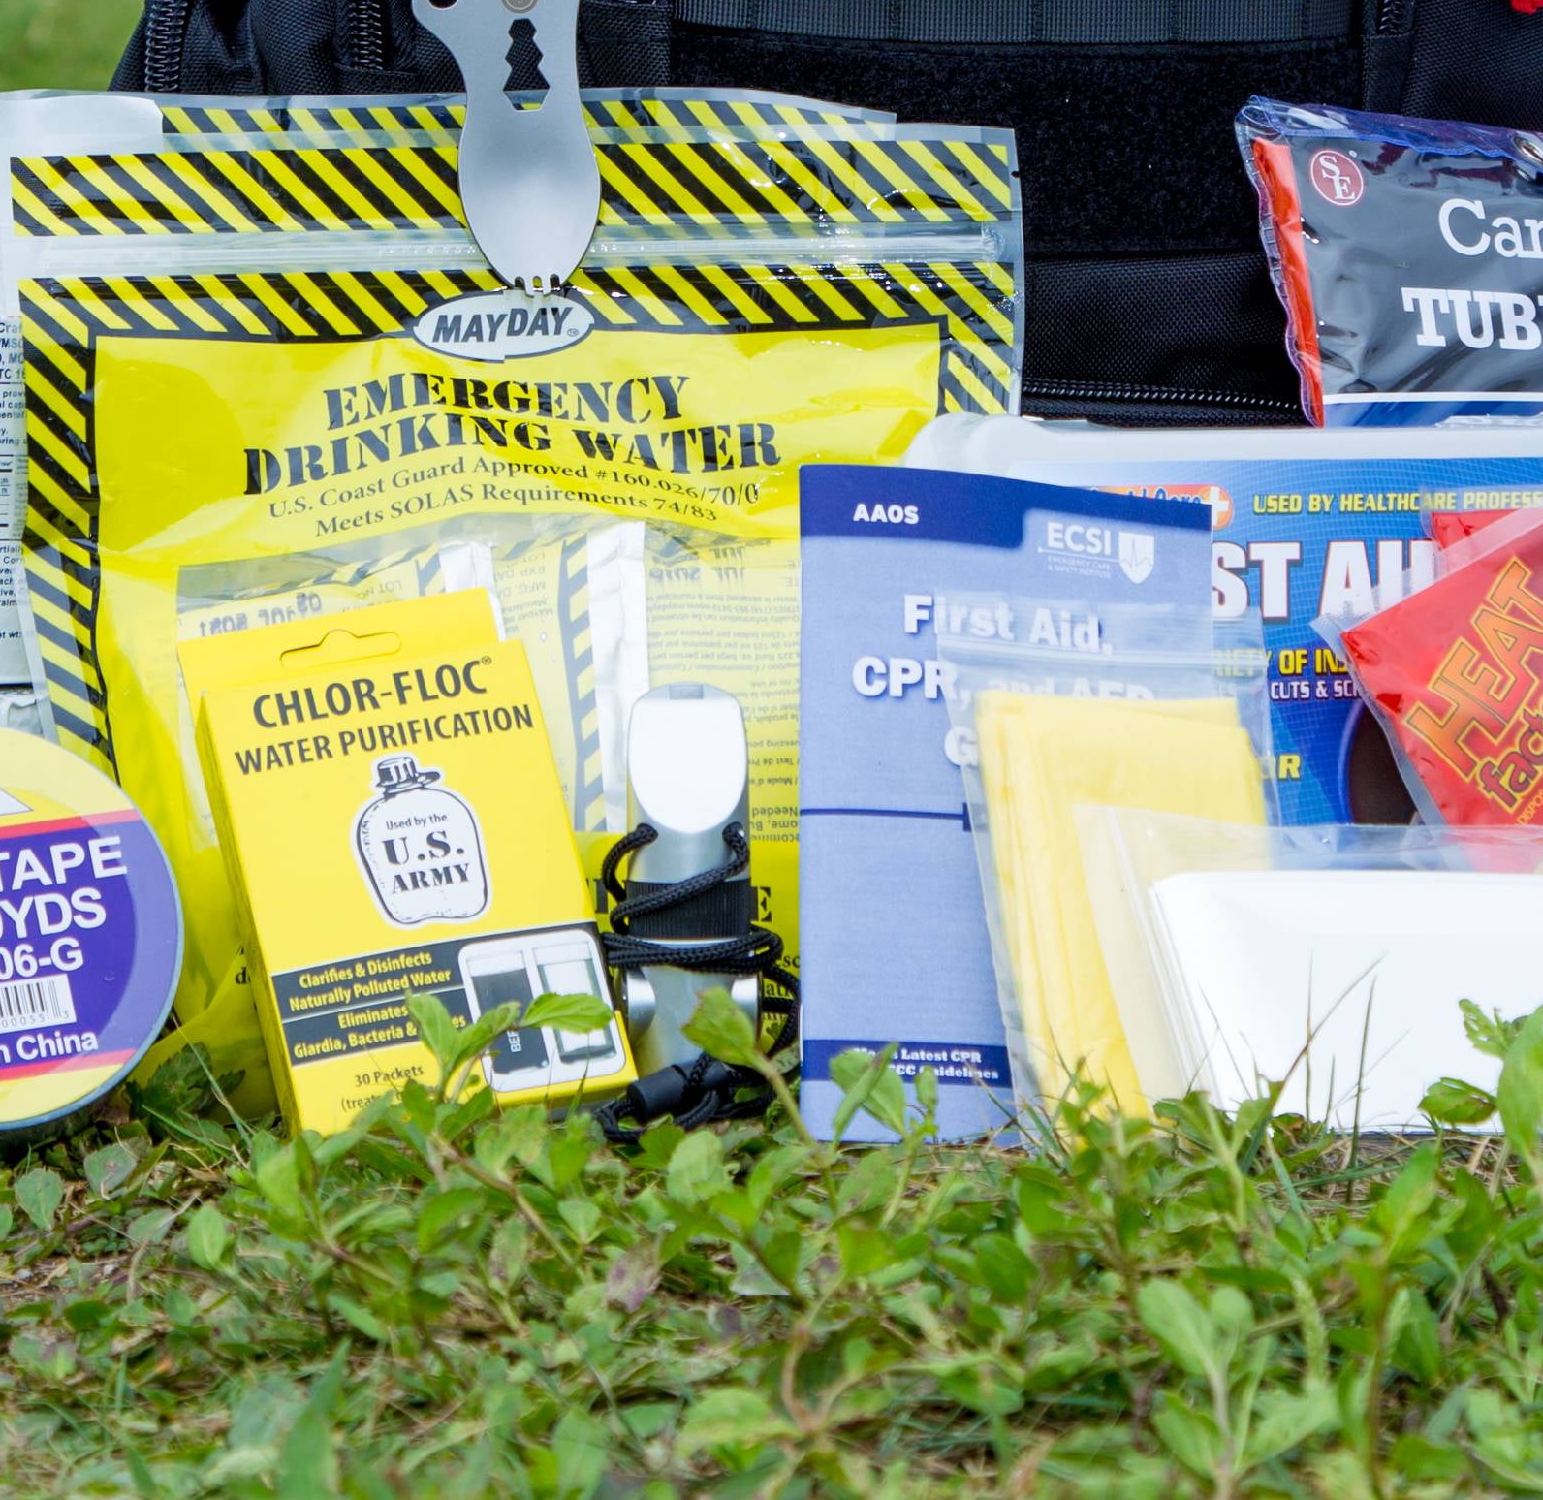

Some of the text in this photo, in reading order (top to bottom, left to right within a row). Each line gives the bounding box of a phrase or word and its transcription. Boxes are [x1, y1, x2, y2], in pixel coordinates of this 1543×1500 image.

[432, 306, 573, 343] MAYDAY
[323, 372, 690, 431] EMERGENCY
[243, 412, 782, 496] DRINKING WATER
[269, 494, 314, 519] U.S.
[319, 479, 385, 508] Coast
[392, 458, 465, 489] Guard
[473, 457, 588, 483] Approved
[1253, 493, 1457, 514] USED BY HEALTHCARE
[315, 484, 717, 538] Meets SOLAS Requirements 74/83
[853, 504, 920, 525] AAOS
[1047, 522, 1111, 555] ECSI
[904, 595, 1014, 640] First
[1279, 649, 1308, 675] OF
[252, 660, 488, 728] CHLOR-FLOC
[1270, 680, 1329, 701] CUTS &
[235, 704, 534, 775] WATER PURIFICATION
[386, 813, 447, 831] Used by the
[381, 830, 465, 866] U.S.
[392, 863, 470, 894] ARMY
[298, 952, 432, 989] Clarifies & Disinfects
[289, 969, 452, 1011] Naturally Polluted Water
[338, 1005, 408, 1028] Eliminates
[16, 1031, 98, 1060] China
[294, 1022, 417, 1058] Giardia, Bacteria &
[901, 1049, 982, 1063] Latest CPR
[355, 1064, 424, 1087] 30 Packets
